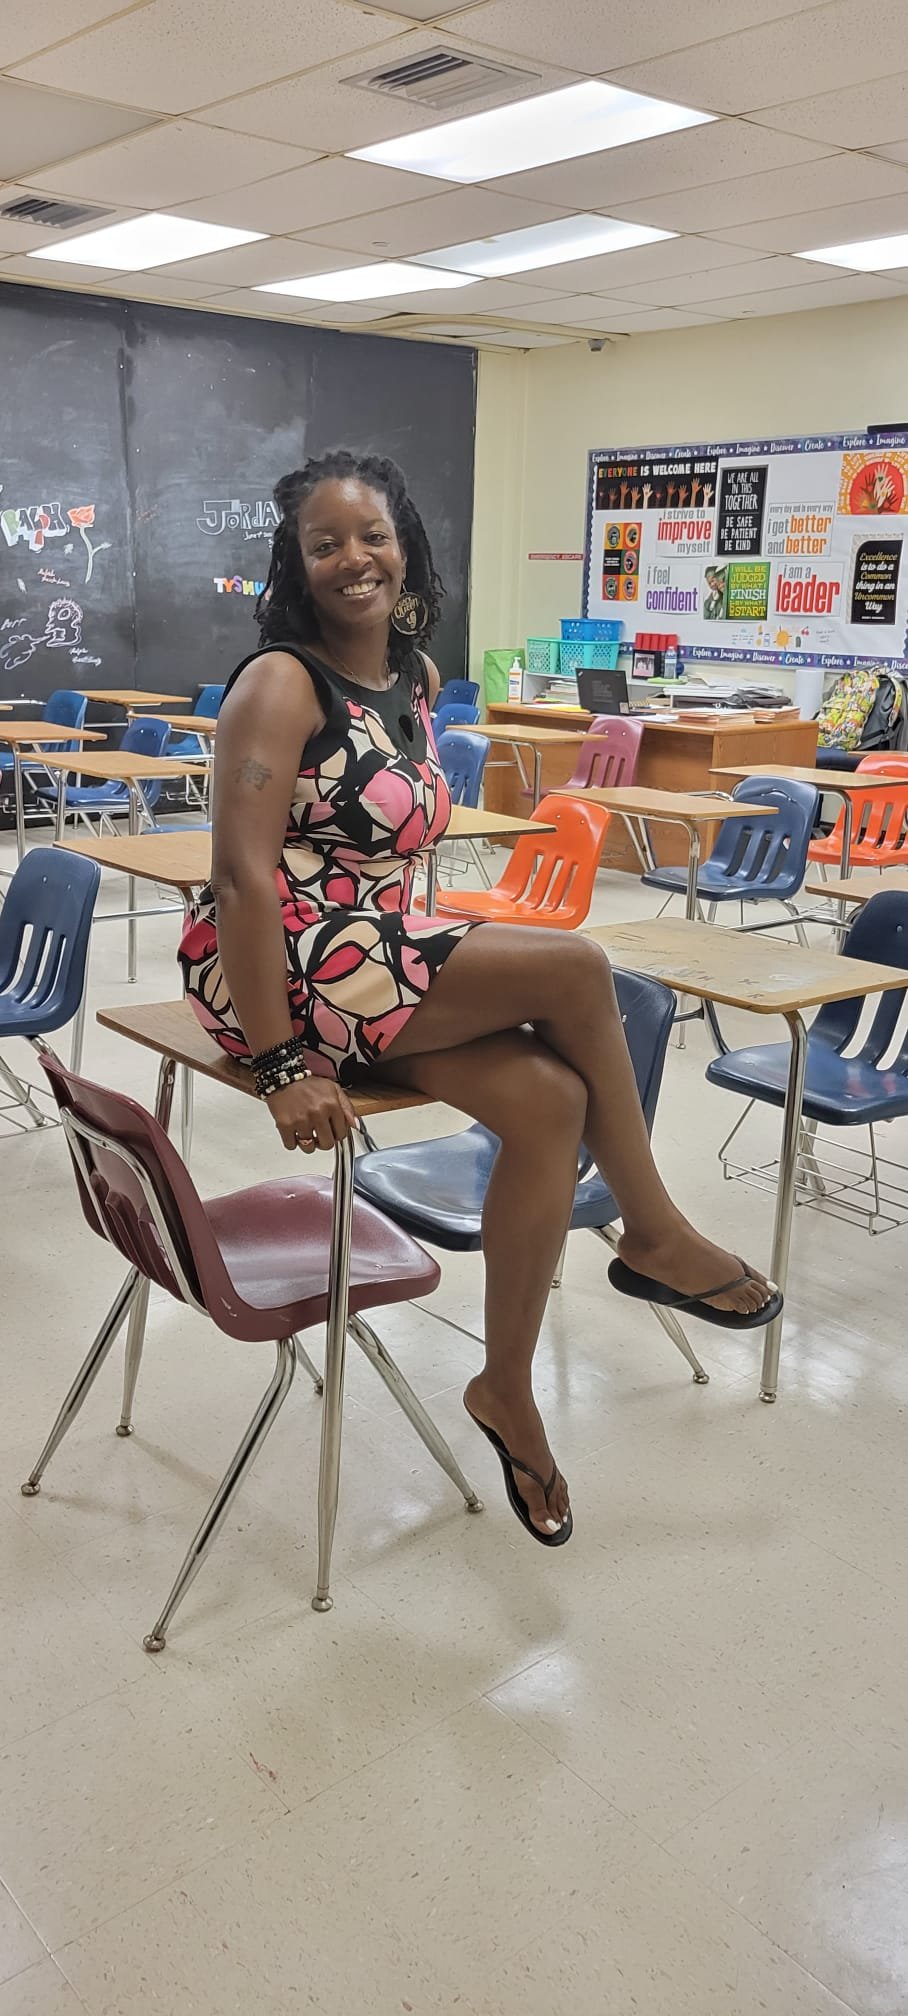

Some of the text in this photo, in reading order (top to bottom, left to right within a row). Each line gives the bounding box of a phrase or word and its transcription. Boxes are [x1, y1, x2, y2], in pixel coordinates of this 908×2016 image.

[706, 446, 727, 456] Explore
[735, 444, 760, 455] Imagine
[770, 443, 794, 453] Discover
[804, 439, 825, 451] Create
[842, 436, 866, 449] Explore
[876, 434, 906, 447] Imagine
[598, 462, 717, 478] EVERYONE IS WELCOME HERE
[727, 471, 759, 484] WE ARE ALL
[731, 483, 753, 494] IN THIS
[725, 494, 758, 511] TOGETHER
[668, 509, 694, 520] strive
[696, 509, 706, 519] to
[725, 516, 753, 527] BE SAFE
[772, 519, 789, 536] get
[790, 514, 832, 534] better
[657, 518, 712, 545] improve
[720, 527, 758, 539] BE PATIENT
[677, 541, 711, 555] myself
[724, 540, 751, 551] BE KIND
[767, 535, 827, 554] and better
[859, 551, 898, 561] Excellence
[735, 565, 753, 573] WILL
[860, 562, 867, 570] is
[868, 562, 876, 571] to
[877, 561, 887, 571] do
[652, 566, 671, 585] feel
[731, 573, 765, 583] JUDGED
[788, 566, 803, 579] am
[805, 566, 811, 579] a
[860, 571, 892, 580] Common
[855, 581, 895, 593] thing in an
[645, 586, 698, 612] confident
[730, 589, 766, 600] FINISH
[776, 574, 840, 613] leader
[854, 592, 895, 600] Uncommon
[735, 606, 766, 617] START
[864, 601, 883, 613] Way
[692, 646, 712, 658] Explore
[719, 648, 744, 661] Imagine
[752, 650, 776, 662] Discover
[785, 653, 804, 665] Create
[821, 655, 844, 667] Explore
